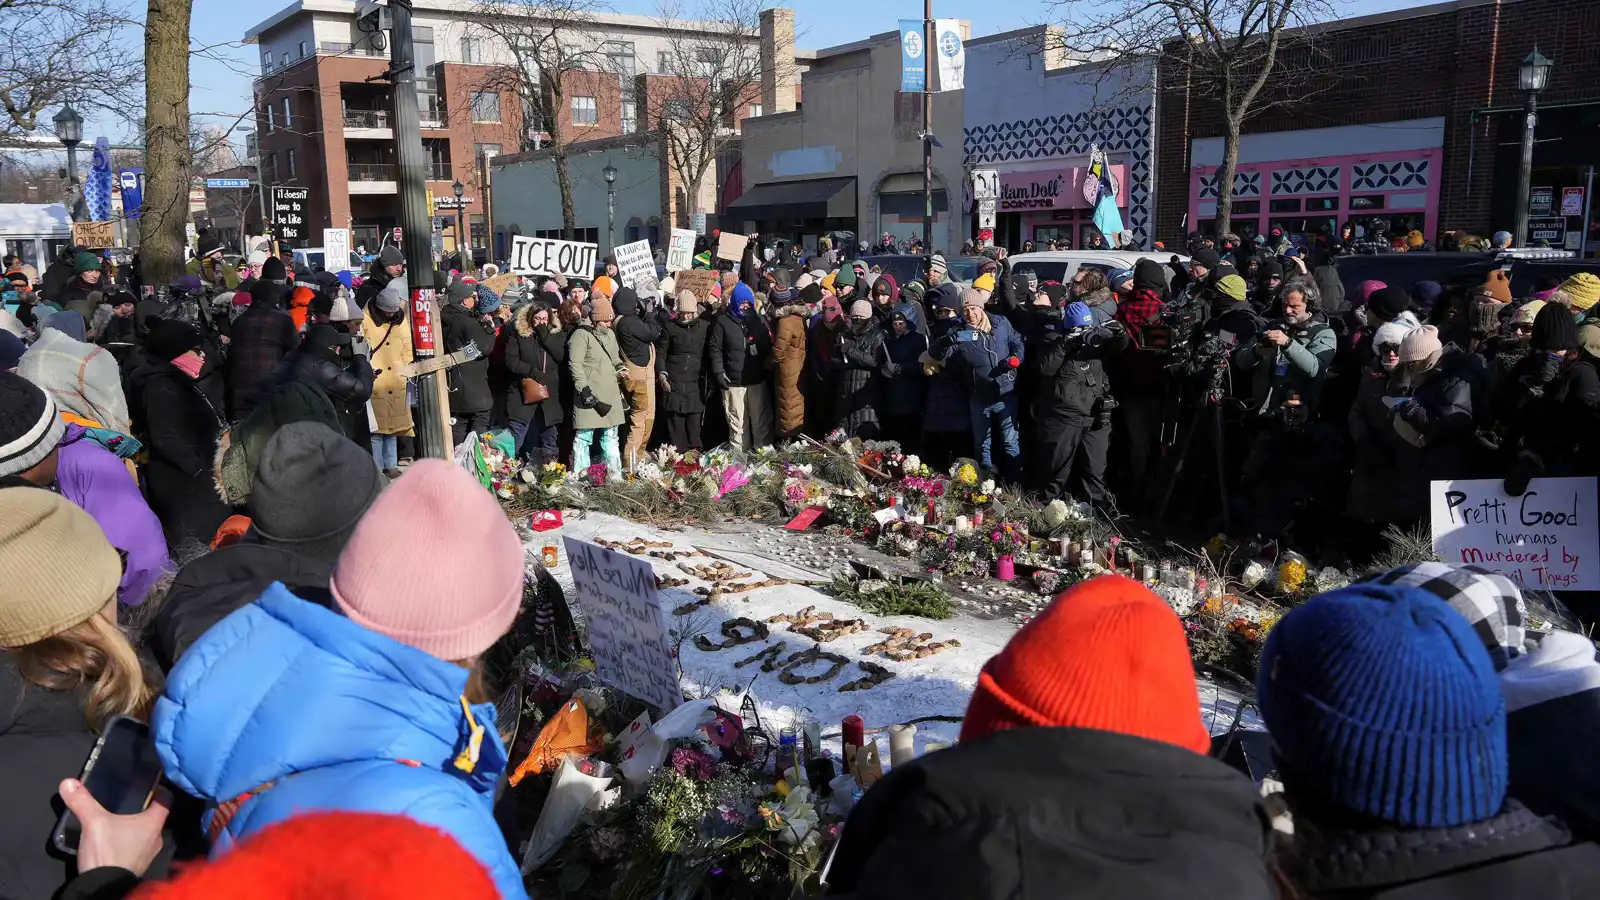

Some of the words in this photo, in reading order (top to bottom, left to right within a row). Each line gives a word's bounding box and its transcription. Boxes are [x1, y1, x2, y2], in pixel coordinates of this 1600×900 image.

[1031, 179, 1060, 198] Doll
[276, 201, 290, 211] have
[292, 201, 301, 211] to
[1532, 195, 1550, 203] FREE
[278, 214, 286, 224] be
[75, 224, 96, 235] ONE
[99, 223, 110, 235] OF
[282, 227, 297, 238] this
[75, 236, 98, 248] OUR
[98, 236, 115, 248] OWN
[329, 231, 344, 243] ICE
[671, 235, 690, 251] ICE
[330, 245, 344, 259] OUT
[513, 241, 556, 274] ICE
[558, 244, 597, 276] OUT
[670, 250, 688, 268] OUT
[1445, 491, 1508, 525] Pretti
[1520, 491, 1578, 527] Good
[1495, 529, 1558, 545] humans
[1460, 547, 1549, 563] Murdered
[1562, 546, 1579, 572] by
[1532, 567, 1579, 587] Thugs
